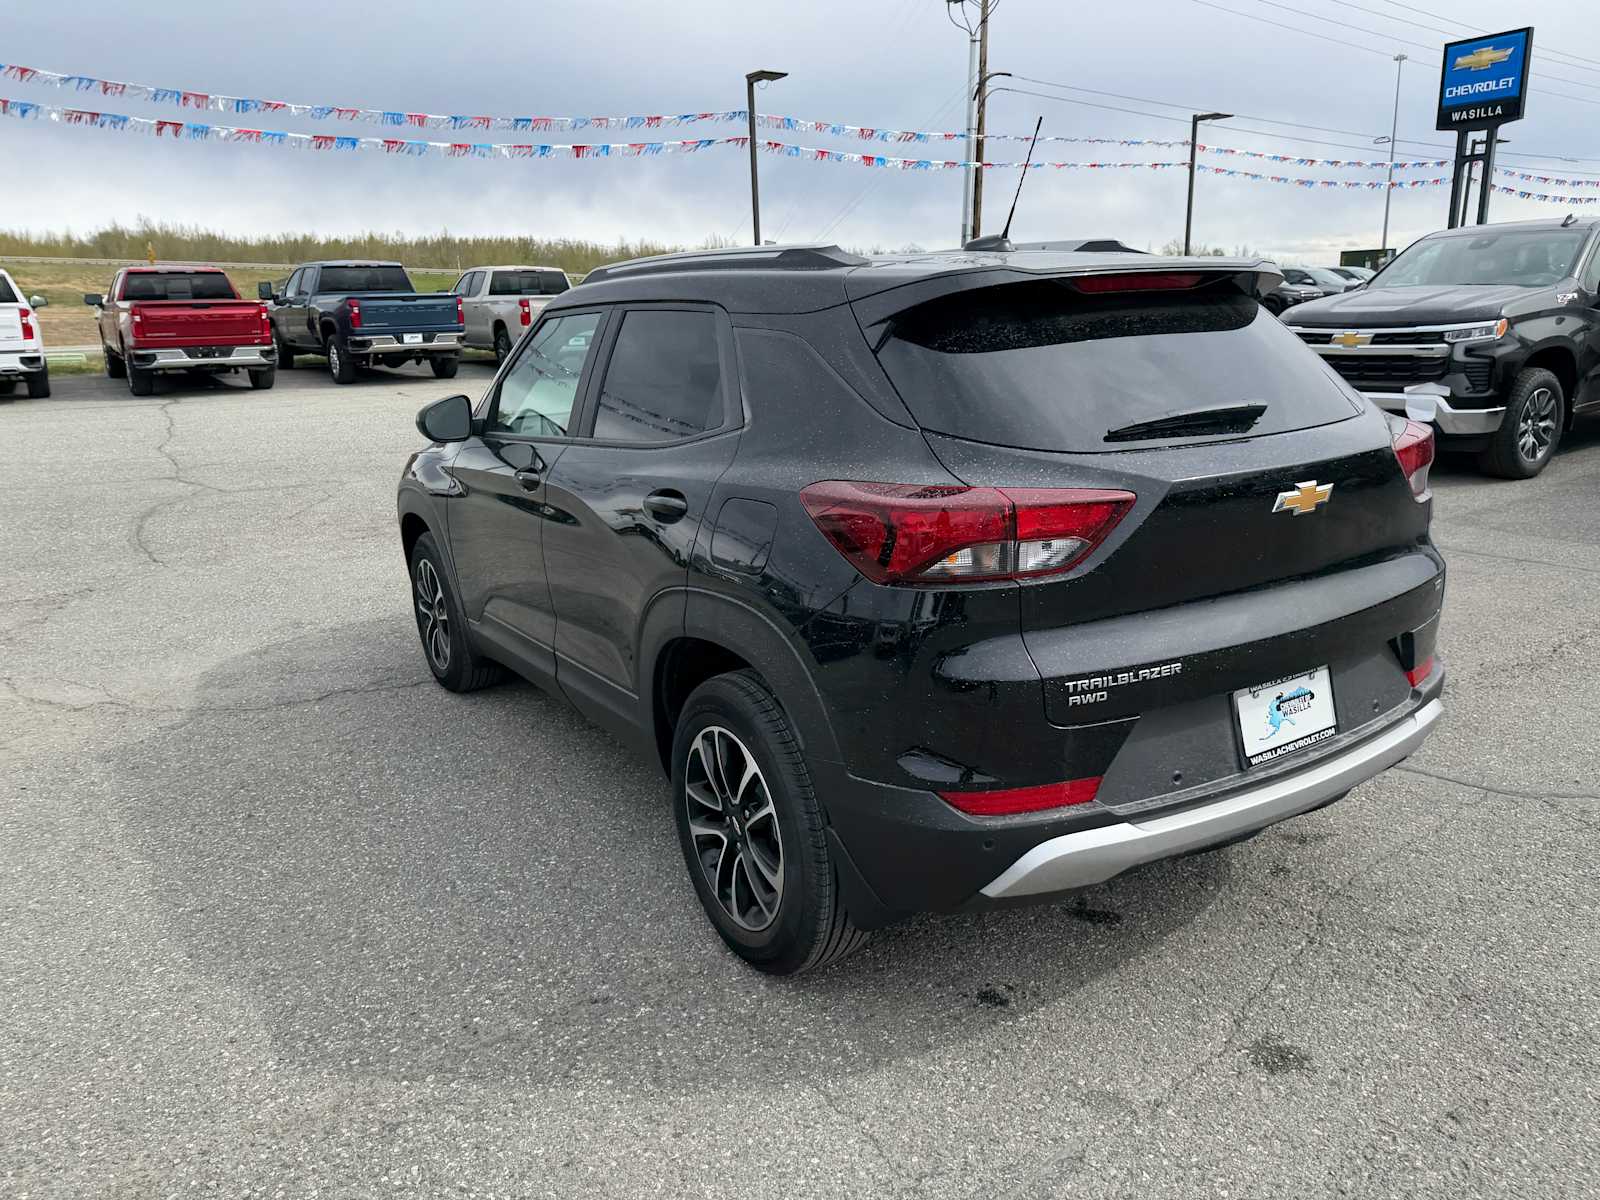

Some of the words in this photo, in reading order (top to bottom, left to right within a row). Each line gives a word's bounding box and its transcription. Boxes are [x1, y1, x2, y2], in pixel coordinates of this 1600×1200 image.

[1445, 77, 1516, 98] CHEVROLET
[1451, 105, 1503, 122] WASILLA
[1064, 662, 1183, 693] TRAILBLAZER
[1068, 691, 1108, 707] AWD
[1281, 701, 1312, 718] WASILLA
[1250, 727, 1337, 766] WASILLACHEVROLET.COM
